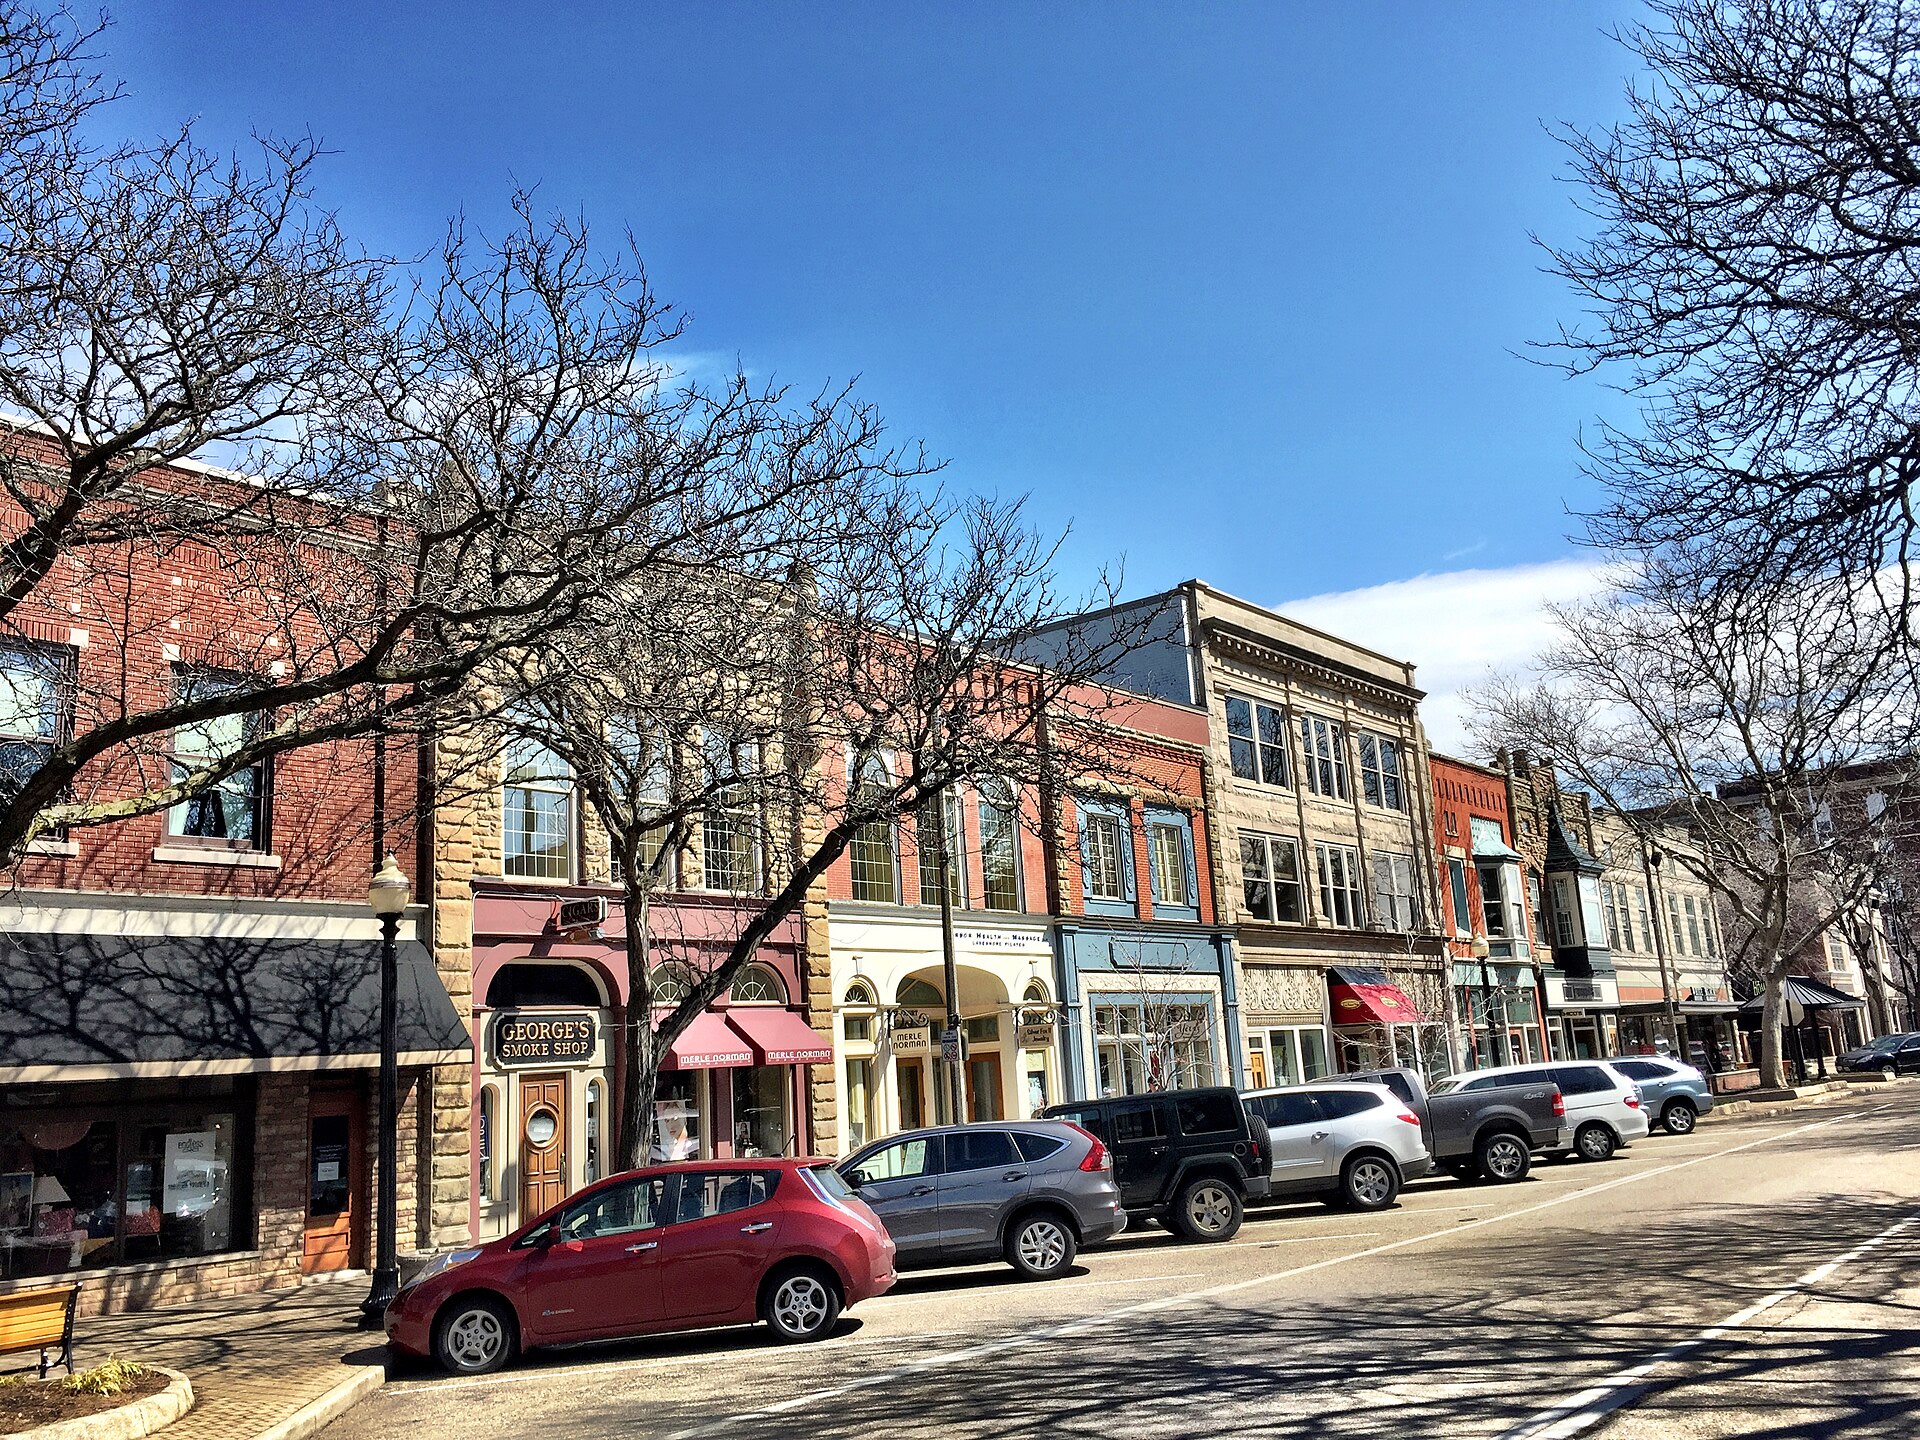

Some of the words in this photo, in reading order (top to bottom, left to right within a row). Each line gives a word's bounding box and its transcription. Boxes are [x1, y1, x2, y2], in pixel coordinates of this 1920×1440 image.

[562, 902, 599, 918] CIGARS
[501, 1021, 590, 1041] GEORGE'S
[896, 1032, 922, 1041] MERLE
[502, 1043, 550, 1057] SMOKE
[553, 1041, 589, 1055] SHOP
[893, 1040, 927, 1050] NORMAN
[680, 1054, 711, 1064] MERLE
[712, 1052, 752, 1062] NORMAN
[767, 1051, 795, 1059] MERLE
[796, 1050, 832, 1058] NORMAN
